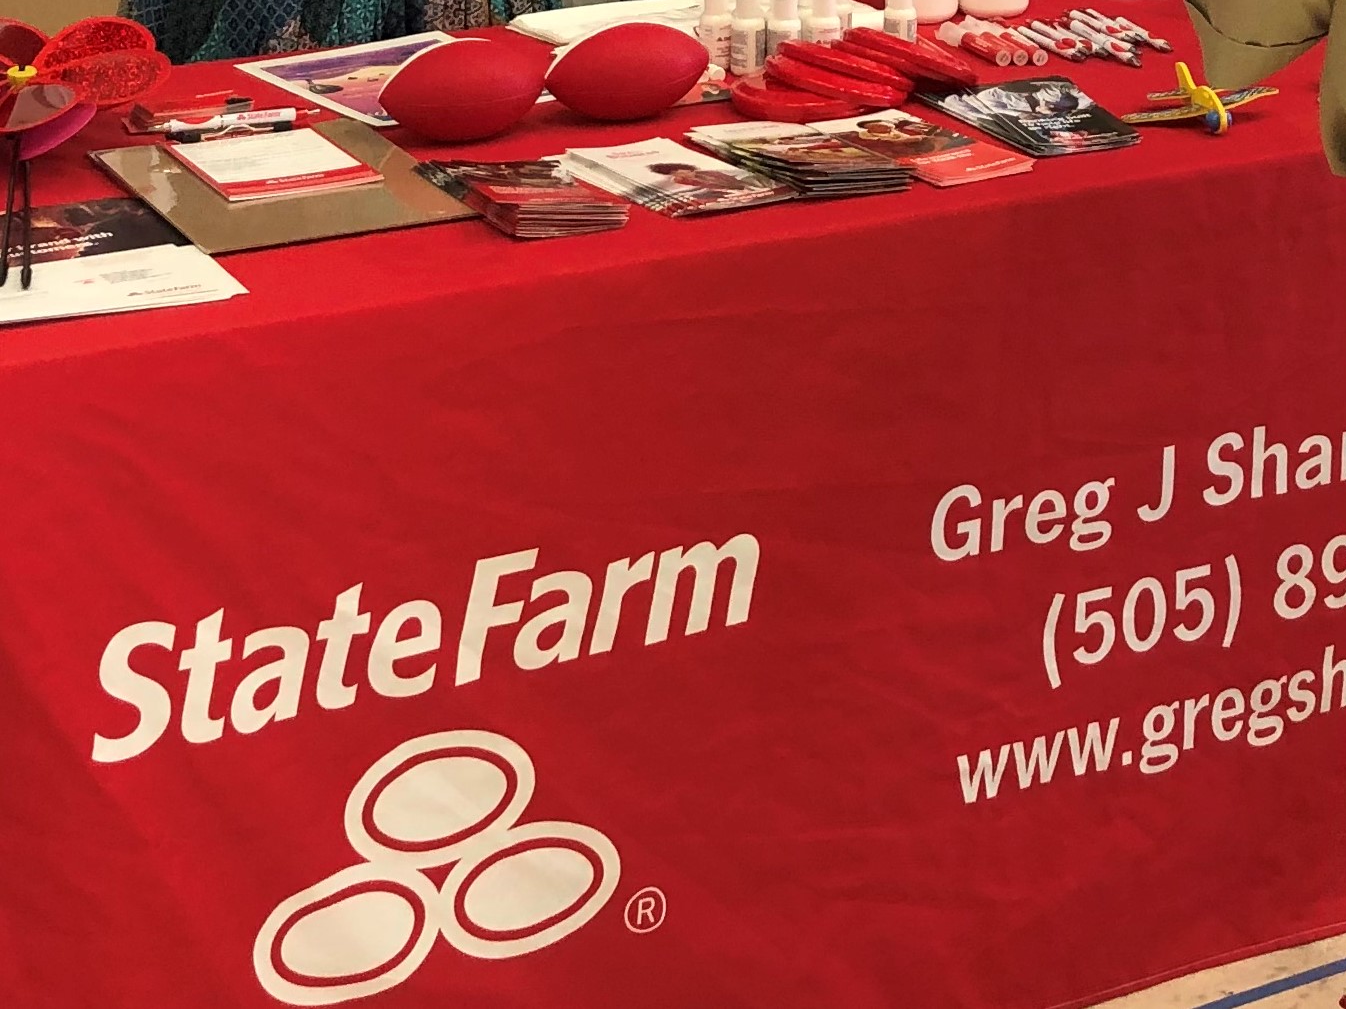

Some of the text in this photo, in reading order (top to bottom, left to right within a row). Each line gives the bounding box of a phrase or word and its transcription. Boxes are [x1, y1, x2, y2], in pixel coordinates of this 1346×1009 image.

[930, 477, 1116, 562] Greg
[1136, 444, 1176, 523] J
[1042, 553, 1242, 690] (505)
